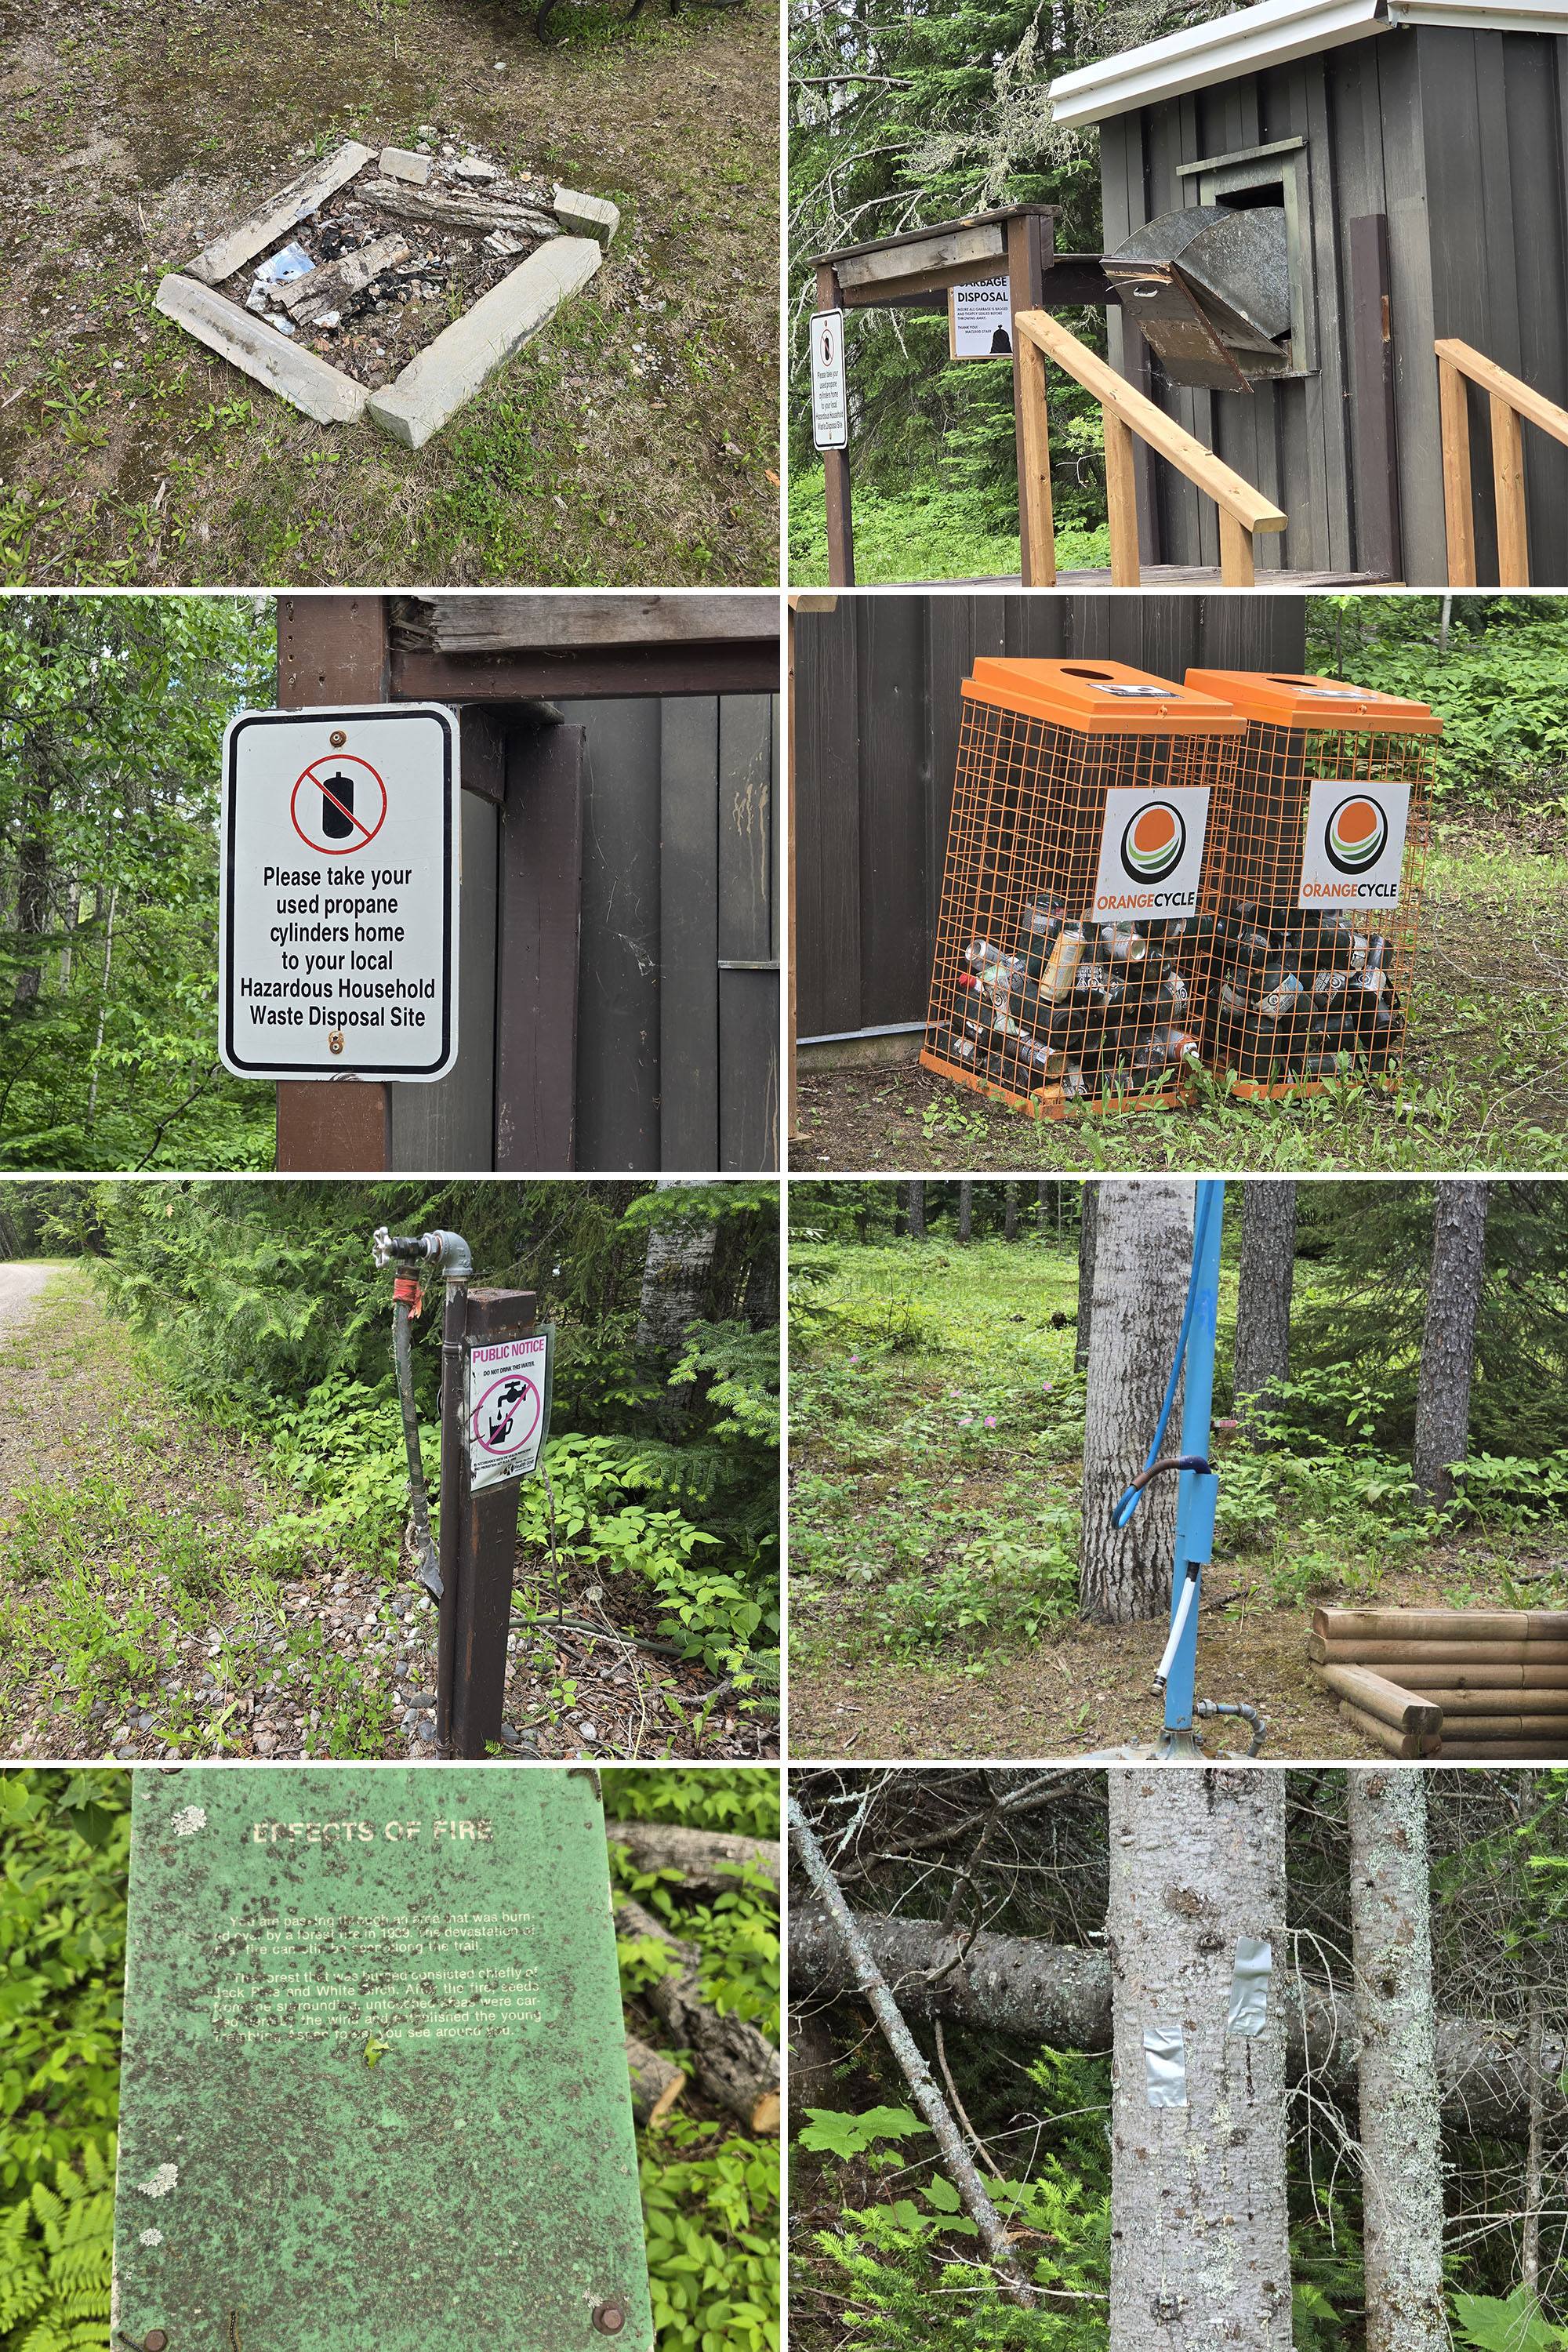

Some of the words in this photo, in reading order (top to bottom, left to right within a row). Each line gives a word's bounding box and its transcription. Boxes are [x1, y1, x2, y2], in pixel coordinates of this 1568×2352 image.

[960, 278, 1007, 287] BAGE
[958, 292, 1008, 302] DISPOSAL
[263, 866, 321, 887] Please
[327, 866, 365, 886] take
[371, 869, 412, 891] your
[1302, 884, 1397, 897] ORANGECYCLE
[277, 894, 319, 914] used
[325, 897, 398, 920] propane
[1097, 891, 1195, 910] ORANGECYCLE
[270, 922, 349, 947] cylinders
[354, 922, 405, 942] home
[281, 951, 299, 970] to
[305, 954, 345, 975] your
[350, 950, 393, 971] local
[241, 978, 332, 998] Hazardous
[338, 978, 435, 999] Household
[249, 1005, 303, 1025] Waste
[309, 1006, 385, 1031] Disposal
[390, 1007, 426, 1027] Site
[473, 1345, 509, 1363] PUBLIC
[512, 1339, 544, 1356] NOTICE
[253, 1822, 374, 1842] EFFECTS
[385, 1820, 421, 1841] OF
[434, 1820, 492, 1842] FIRE
[230, 1917, 255, 1926] You
[260, 1918, 279, 1926] are
[502, 1912, 535, 1922] burn-
[267, 1930, 281, 1943] by
[285, 1931, 293, 1940] a
[297, 1929, 335, 1940] forest
[365, 1929, 376, 1938] in
[445, 1925, 517, 1937] devastation
[523, 1924, 535, 1935] of
[428, 1941, 448, 1951] the
[454, 1940, 483, 1951] trail.
[411, 1969, 474, 1980] consisted
[478, 1966, 521, 1980] chiefly
[525, 1966, 538, 1977] of
[214, 1987, 245, 1998] Jack
[286, 1986, 310, 1997] and
[316, 1985, 354, 1996] White
[443, 1982, 464, 1994] the
[470, 1982, 495, 1994] fire,
[501, 1981, 539, 1992] seeds
[481, 1998, 512, 2007] were
[517, 1996, 541, 2006] car-
[301, 2014, 322, 2025] the
[475, 2010, 496, 2021] the
[501, 2009, 542, 2023] young
[378, 2029, 402, 2040] you
[407, 2028, 430, 2038] see
[436, 2026, 481, 2037] around
